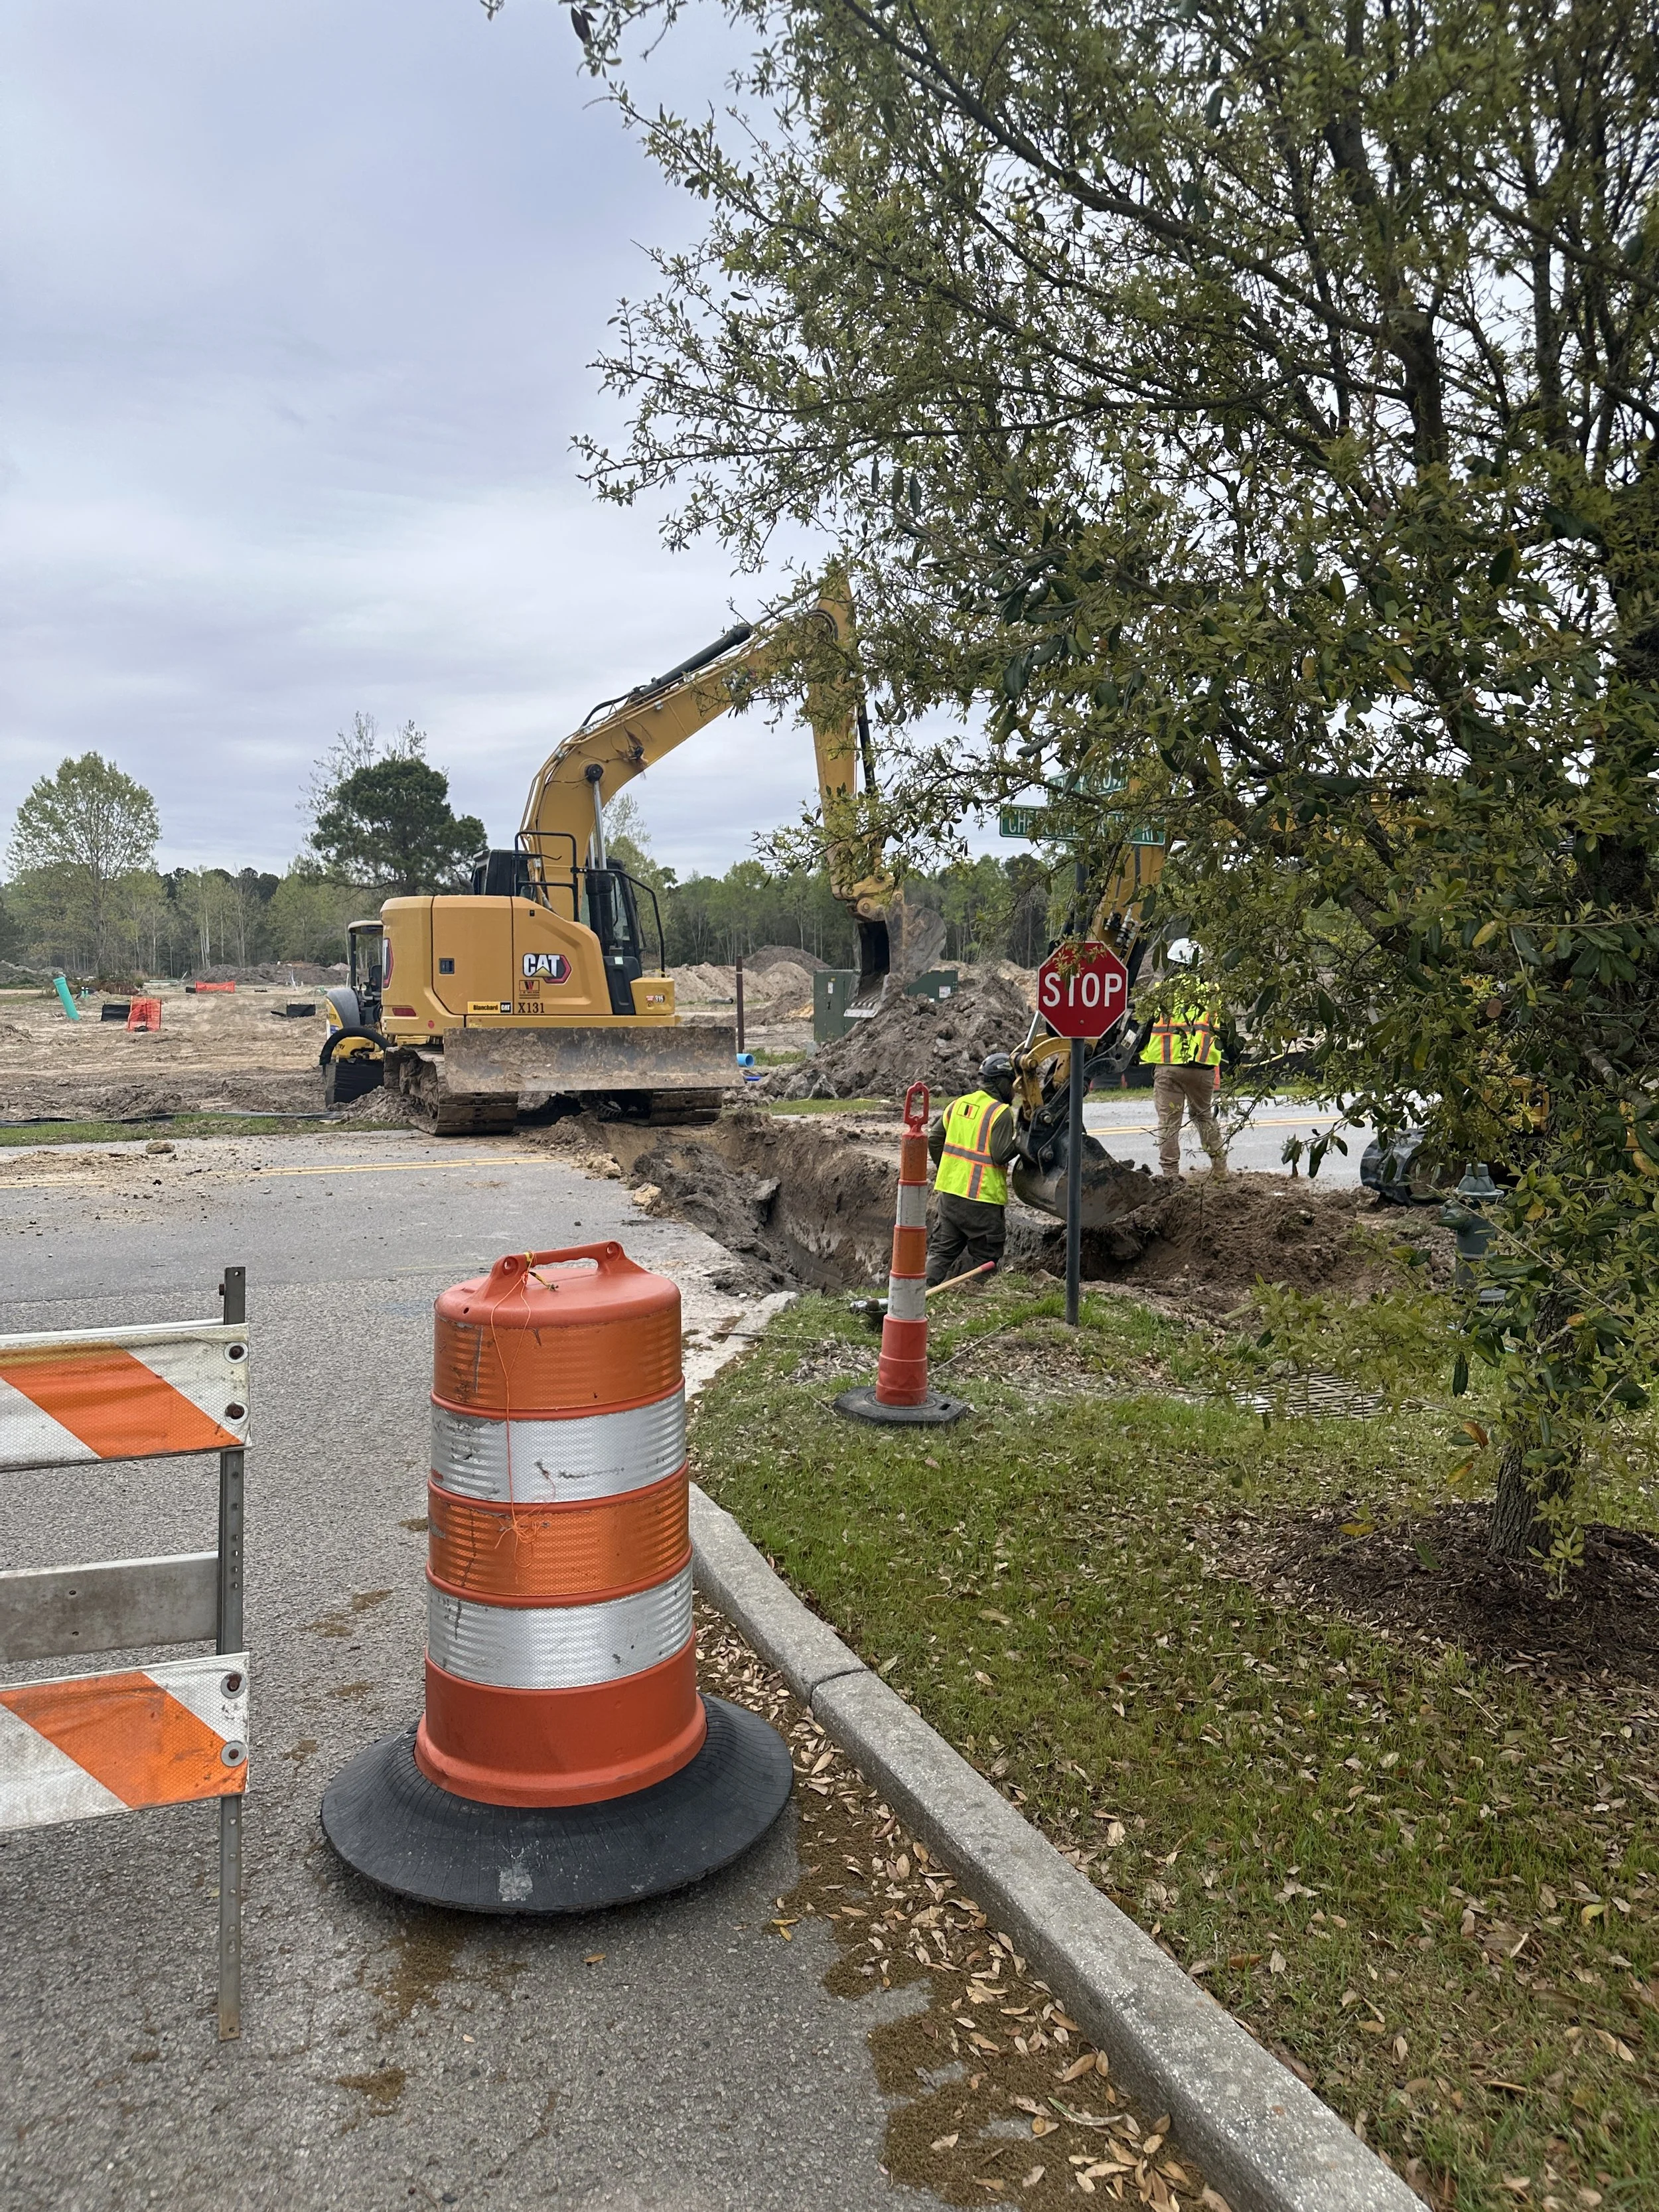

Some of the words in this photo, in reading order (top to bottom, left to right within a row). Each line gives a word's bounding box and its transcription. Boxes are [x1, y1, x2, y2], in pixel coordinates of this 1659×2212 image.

[524, 953, 560, 977] CAT
[1043, 972, 1122, 1007] STOP
[518, 1002, 545, 1013] X131
